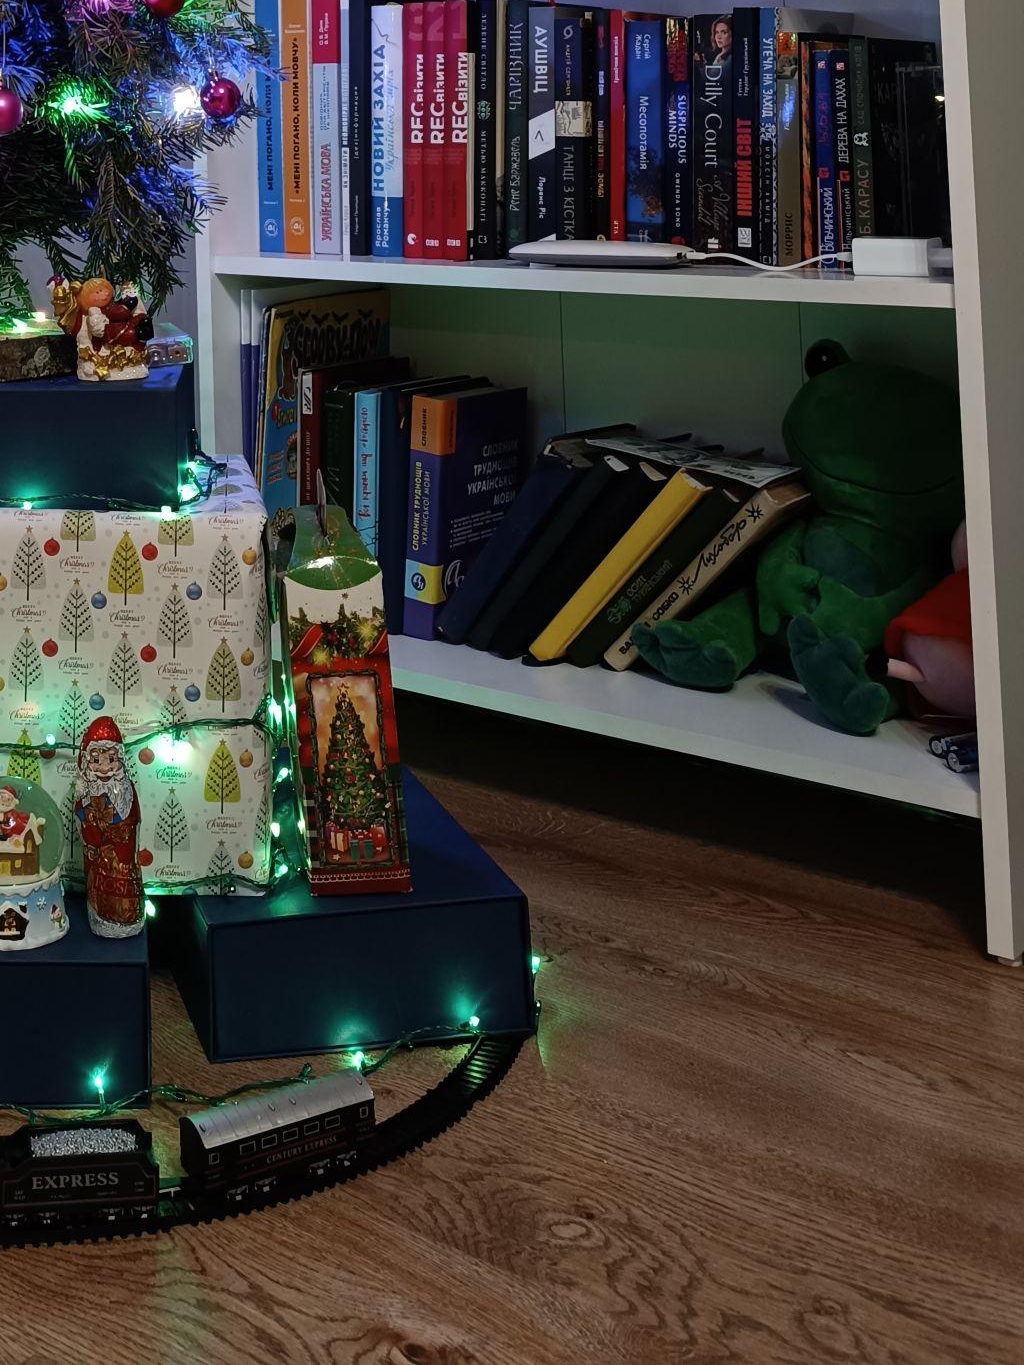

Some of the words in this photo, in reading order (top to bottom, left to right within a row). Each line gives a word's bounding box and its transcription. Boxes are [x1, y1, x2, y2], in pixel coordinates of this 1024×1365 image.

[532, 25, 549, 95] АУШВІЦ
[635, 34, 643, 60] Жадан
[643, 34, 652, 60] Сергій
[762, 37, 774, 71] УТЕЧА
[372, 44, 386, 111] ЗАХІД
[480, 53, 488, 90] СВІТЛО
[508, 22, 524, 111] ЧАРІВНИК
[762, 73, 773, 86] НА
[264, 84, 273, 108] КОЛИ
[292, 82, 301, 112] КОЛИ
[700, 64, 723, 107] Dilly
[761, 88, 774, 118] ЗАХІД
[834, 77, 849, 109] ДАХАХ
[265, 110, 275, 161] ПОГАНО,
[638, 95, 649, 171] Месопотамія
[668, 109, 678, 150] MINDS
[678, 95, 687, 165] SUSPICIOUS
[835, 110, 848, 125] НА
[292, 113, 302, 161] ПОГАНО,
[372, 118, 386, 192] НОВИЙ
[479, 130, 487, 163] МЕТЬЮ
[704, 113, 723, 169] Court
[735, 117, 753, 158] СВІТ
[834, 127, 850, 164] ДЕРЕВА
[265, 164, 275, 192] МЕНІ
[320, 144, 333, 177] МОВА
[509, 135, 522, 187] Баржавель
[562, 145, 577, 181] ТАНЦІ
[509, 188, 521, 212] Рене
[538, 176, 546, 205] Лоренс
[564, 185, 575, 193] З
[733, 159, 753, 218] ІНШИЙ
[856, 159, 871, 219] КАРАСУ
[319, 179, 333, 243] УКРАЇНСЬКА
[538, 207, 547, 219] Ріс
[562, 198, 576, 242] КІСТКА
[860, 222, 872, 235] Б.
[413, 461, 423, 510] ТРУДНОЩІВ
[422, 470, 431, 495] МОВИ
[411, 511, 421, 551] СЛОВНИК
[420, 496, 431, 546] УКРАЇНСЬКОЇ
[652, 592, 680, 622] СОБКО
[266, 1146, 303, 1165] CENTURY
[305, 1135, 337, 1153] EXPRESS
[31, 1171, 120, 1191] EXPRESS
